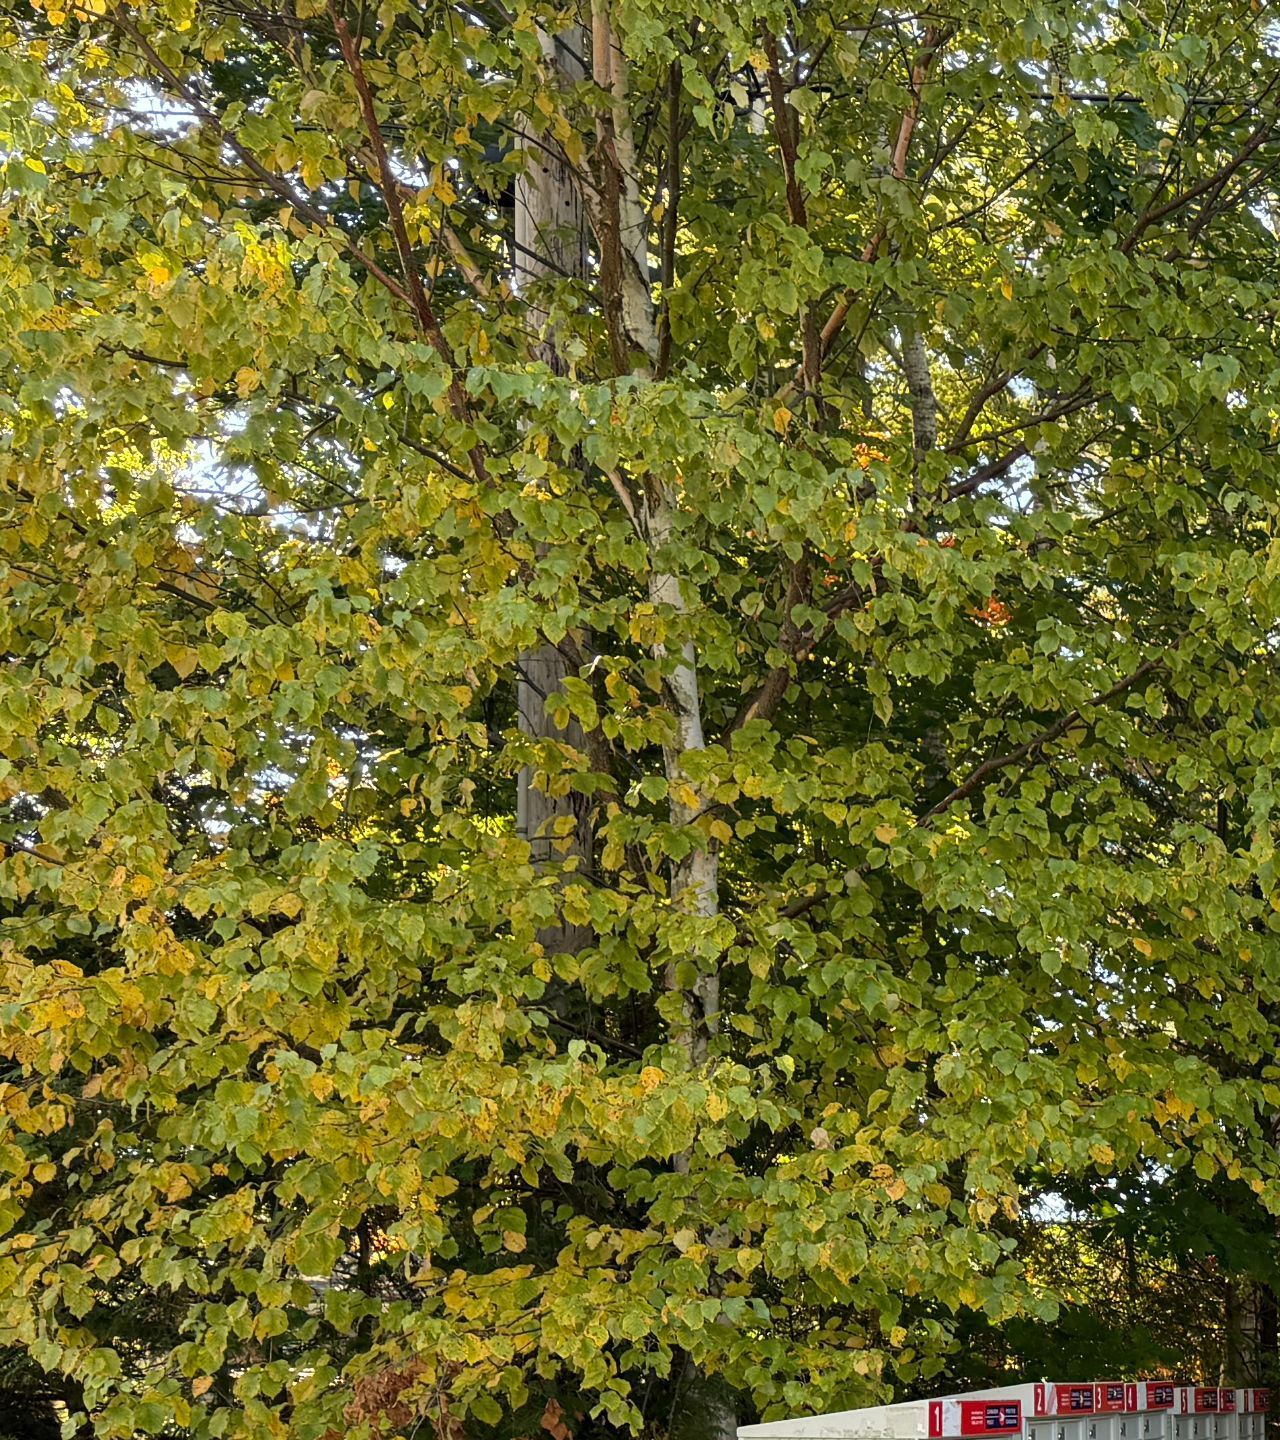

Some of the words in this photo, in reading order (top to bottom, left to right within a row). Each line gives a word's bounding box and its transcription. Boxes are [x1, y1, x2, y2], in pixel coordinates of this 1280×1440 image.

[1037, 1388, 1042, 1412] 2
[1097, 1387, 1102, 1409] 3
[1128, 1387, 1133, 1408] 4
[934, 1406, 940, 1433] 1
